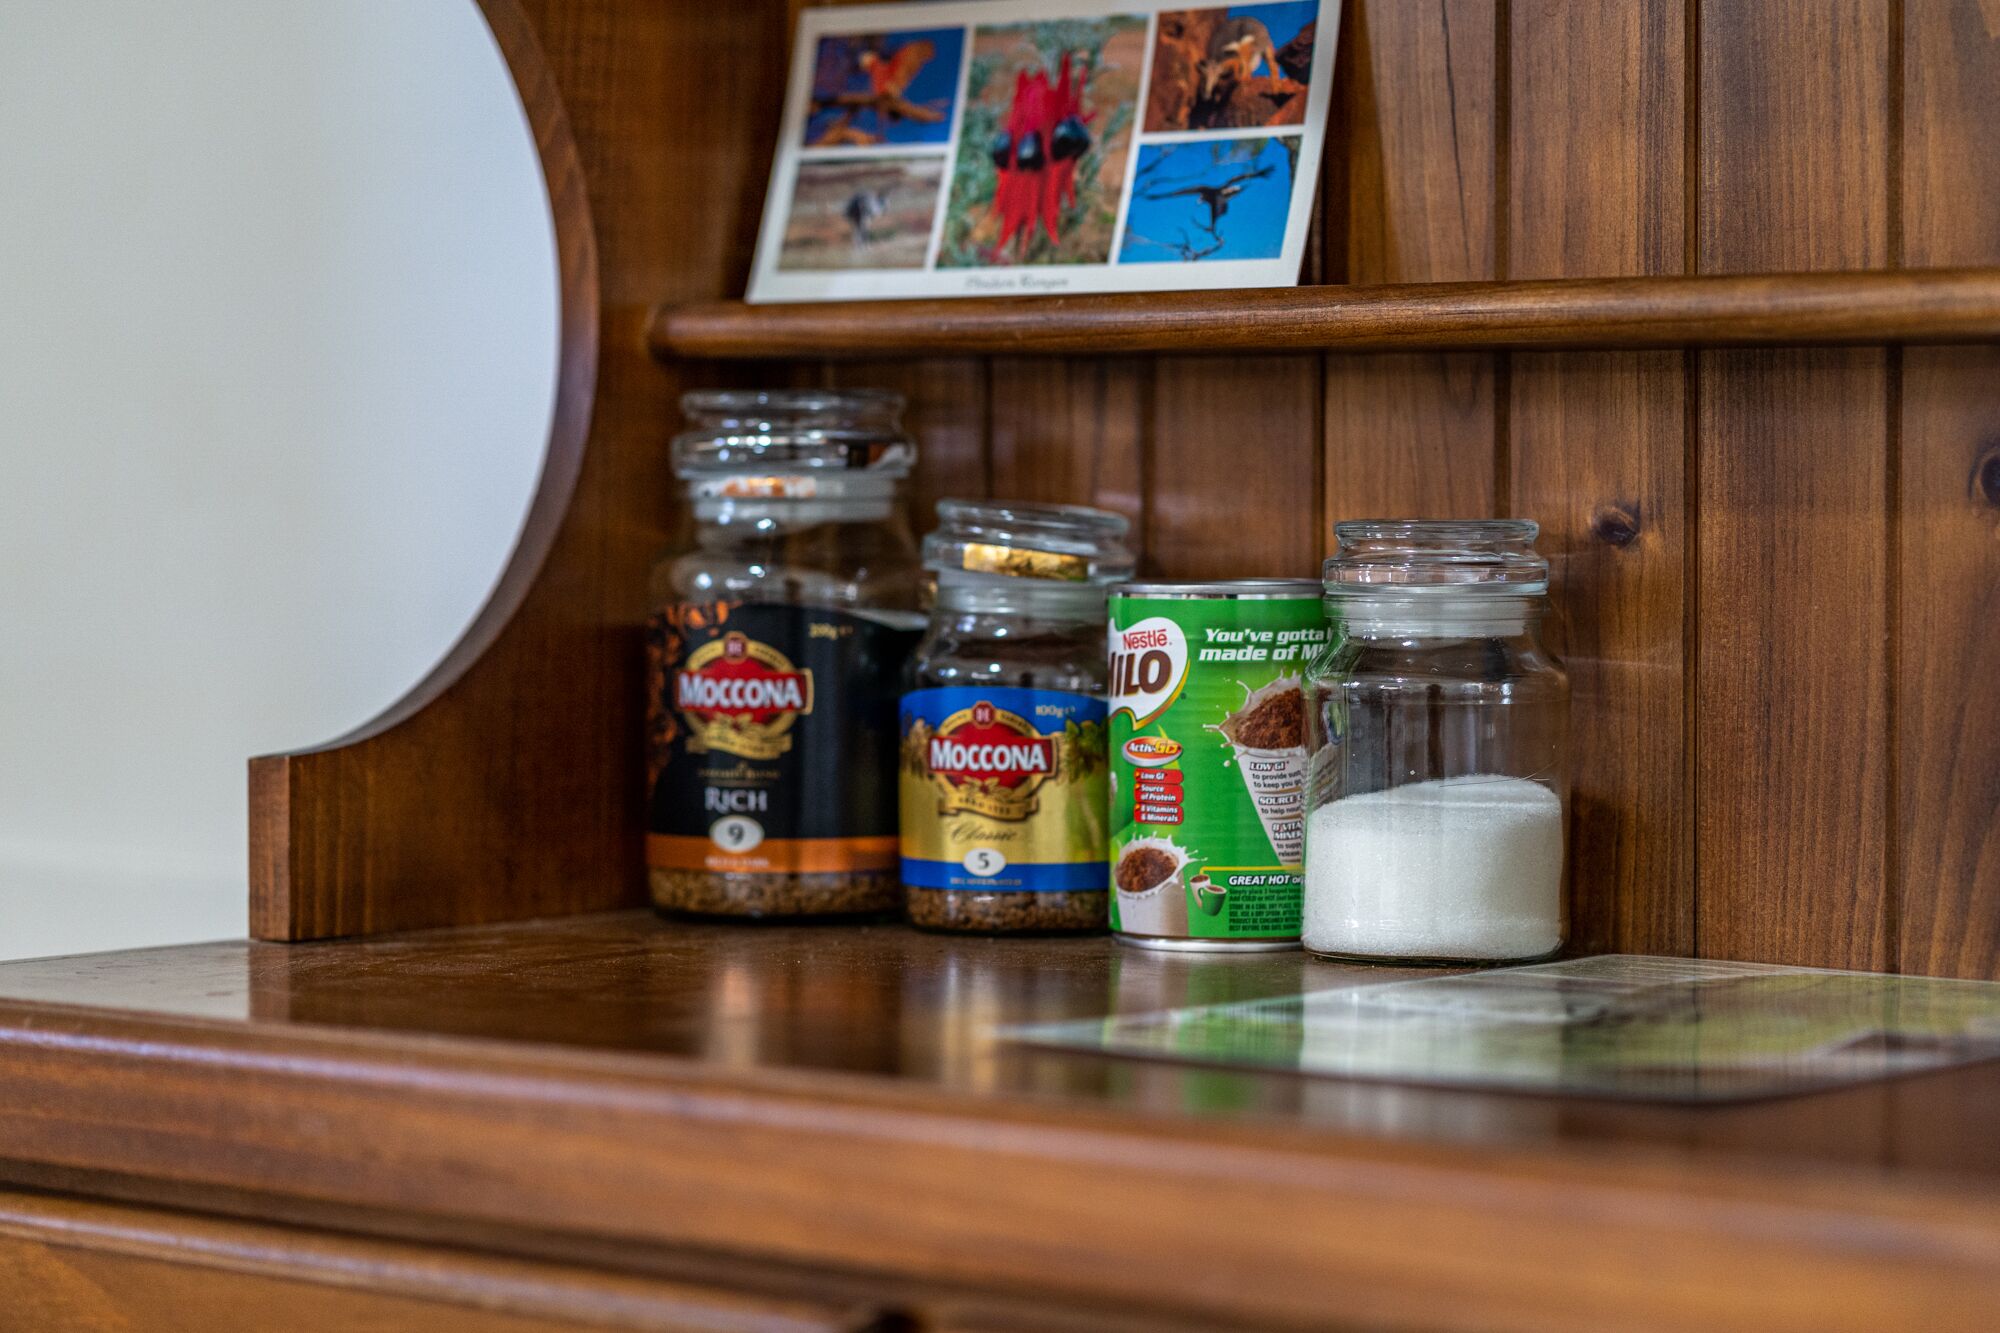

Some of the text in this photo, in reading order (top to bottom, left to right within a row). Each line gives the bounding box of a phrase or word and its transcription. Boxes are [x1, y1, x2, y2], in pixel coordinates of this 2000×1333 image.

[1205, 629, 1273, 642] You've
[1276, 629, 1324, 645] gotta
[1199, 645, 1268, 661] made
[1272, 645, 1299, 660] of
[679, 673, 803, 708] MOCCONA
[931, 739, 1048, 772] MOCCONA
[1250, 762, 1272, 771] LOW
[1262, 772, 1287, 781] provide
[1263, 781, 1280, 789] keep
[704, 787, 768, 814] RICH
[1149, 794, 1176, 802] Protein
[1147, 805, 1178, 814] Vitamins
[1270, 807, 1285, 815] help
[1147, 814, 1178, 822] Minerals
[727, 823, 745, 846] 9
[978, 852, 990, 870] 5
[1229, 875, 1266, 885] GREAT
[1268, 874, 1290, 885] HOT
